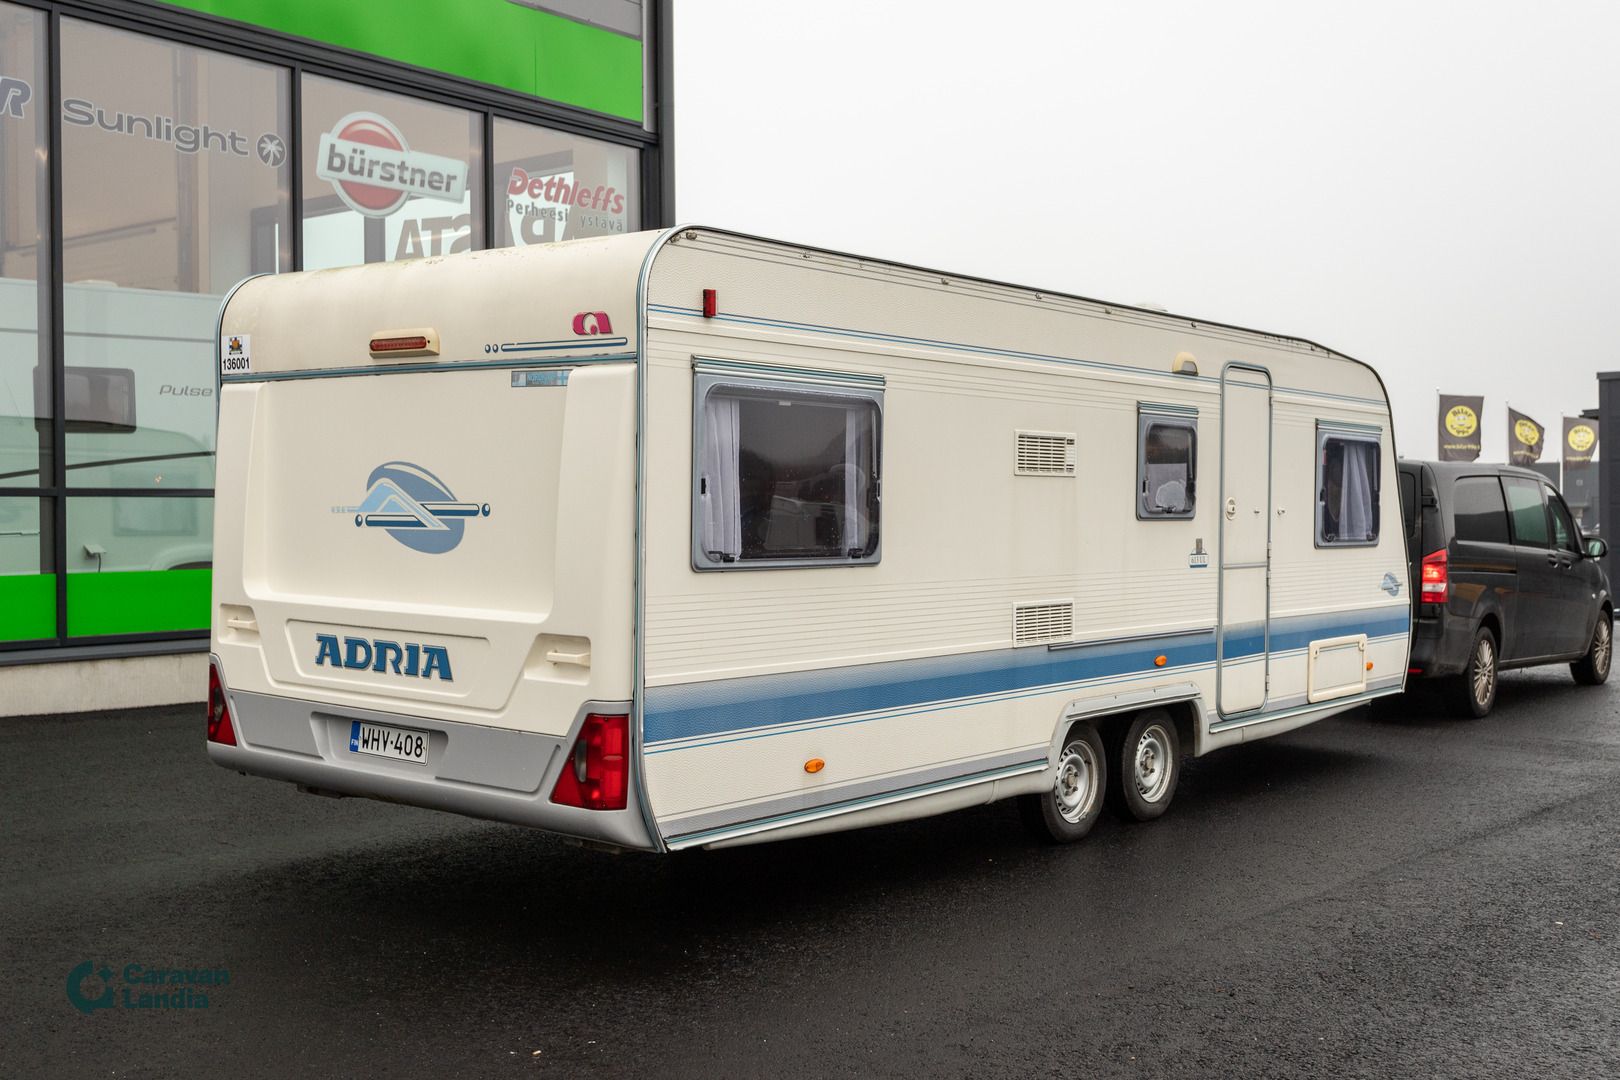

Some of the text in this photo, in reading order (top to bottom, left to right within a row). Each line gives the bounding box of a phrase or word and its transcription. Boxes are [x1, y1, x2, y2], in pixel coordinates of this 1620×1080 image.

[62, 98, 250, 156] Sunlight
[327, 143, 458, 194] bürstner
[507, 167, 625, 214] Dethleffs
[507, 199, 569, 222] Perheesi
[222, 357, 250, 371] 136001
[159, 384, 213, 397] Pulse
[315, 633, 453, 682] ADRIA
